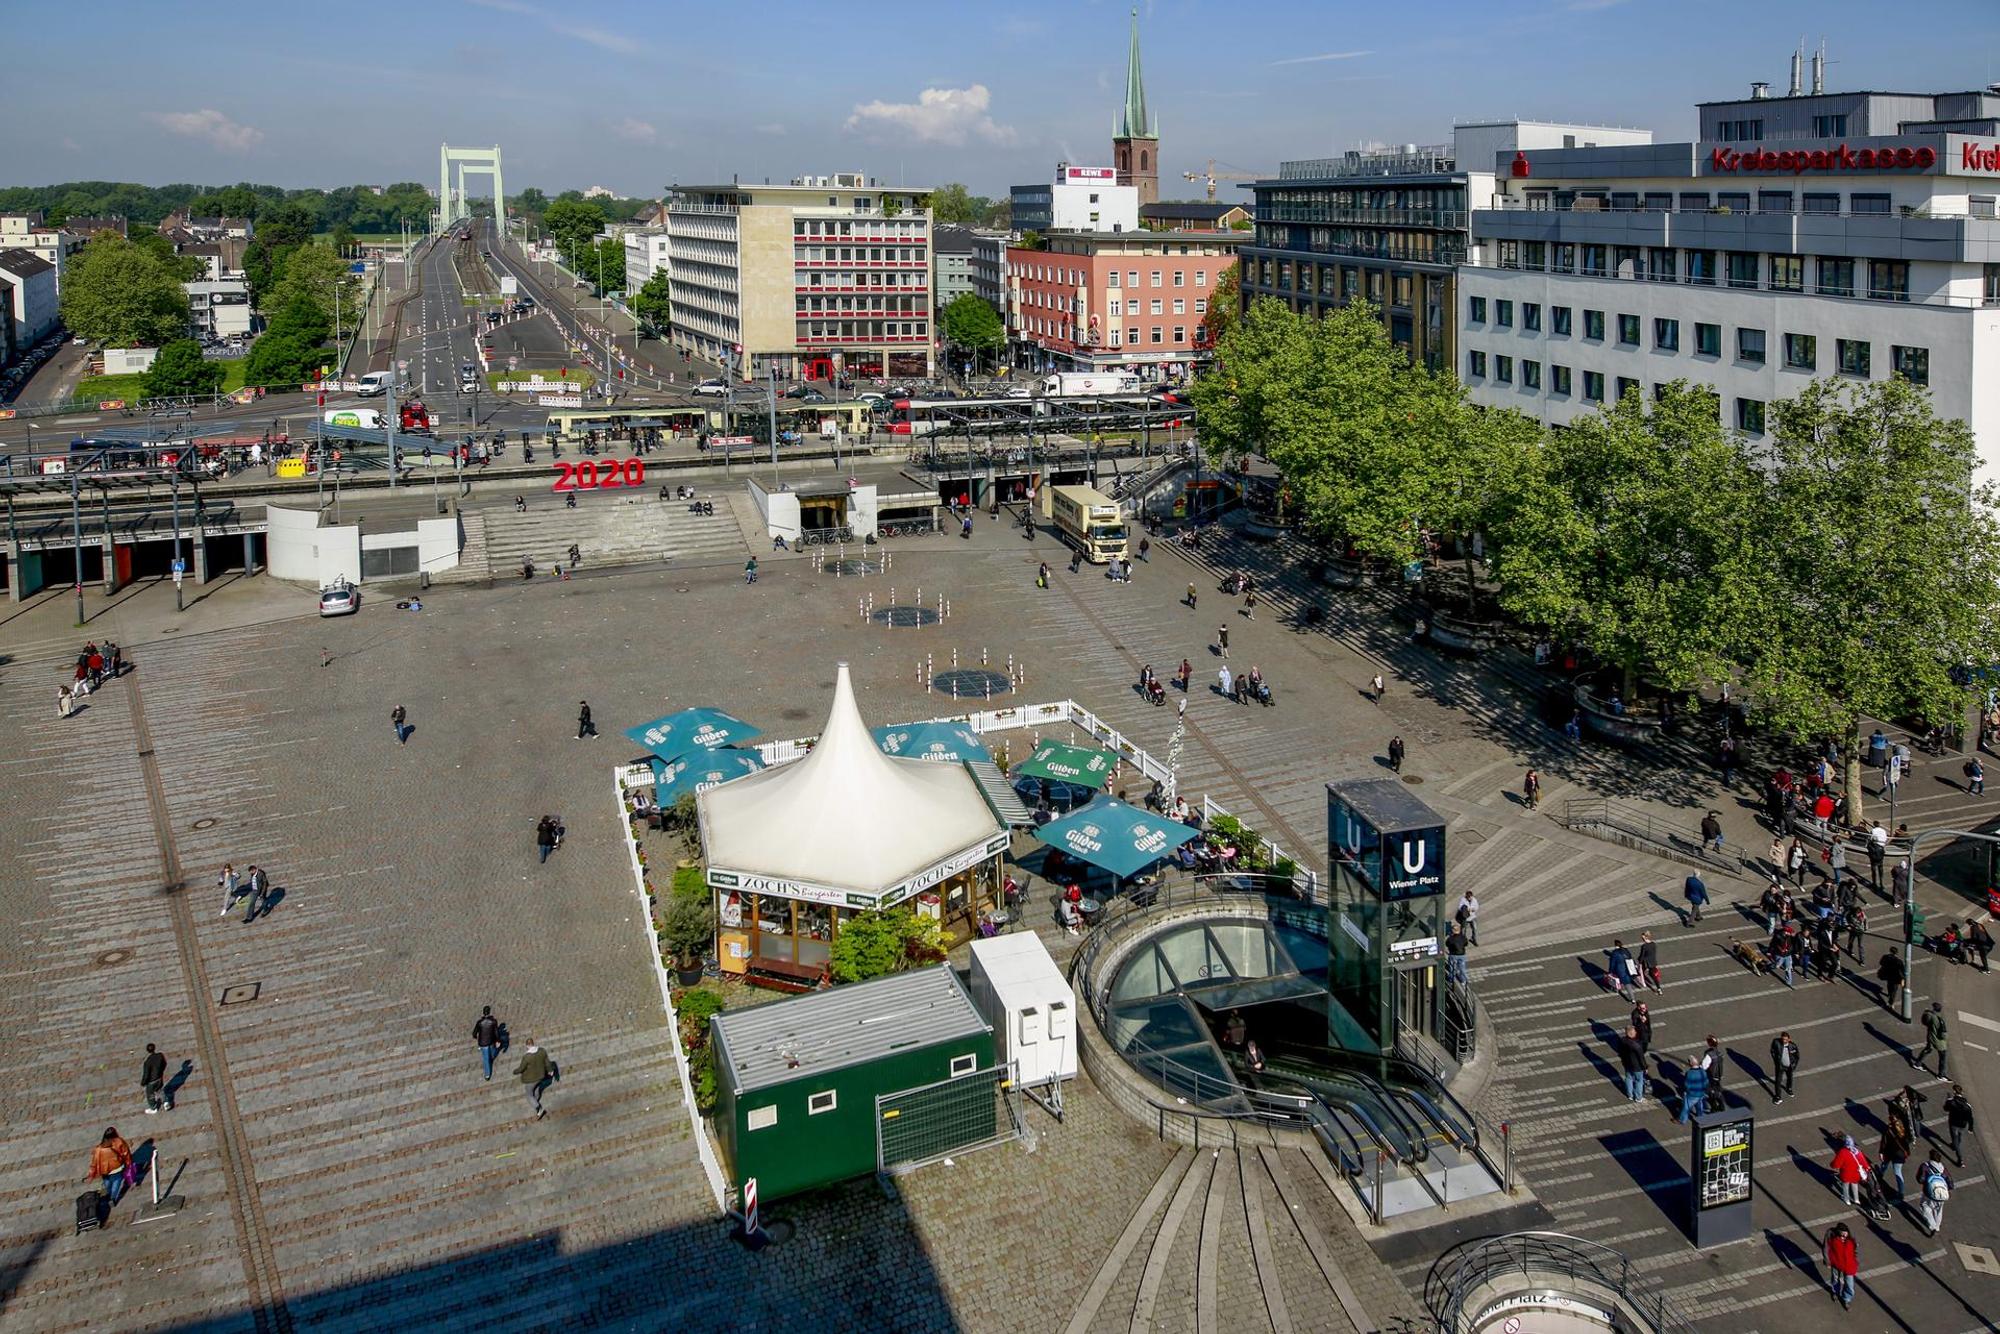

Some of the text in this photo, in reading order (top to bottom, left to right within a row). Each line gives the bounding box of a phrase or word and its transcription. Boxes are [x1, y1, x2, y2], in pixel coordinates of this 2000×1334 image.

[1712, 143, 1936, 173] Kreissparkasse
[1080, 169, 1102, 177] REWE
[553, 457, 644, 491] 2020
[693, 729, 729, 744] Gilden
[921, 752, 959, 761] Gilden
[1046, 762, 1080, 776] Gilden
[1065, 829, 1102, 852] Gilden
[1133, 829, 1167, 852] Gilden
[1347, 817, 1360, 854] U
[1403, 839, 1425, 874] U
[742, 877, 842, 900] ZOCH'S Biergarten
[909, 863, 954, 892] ZOCH'S
[1389, 876, 1439, 889] Wiener Platz
